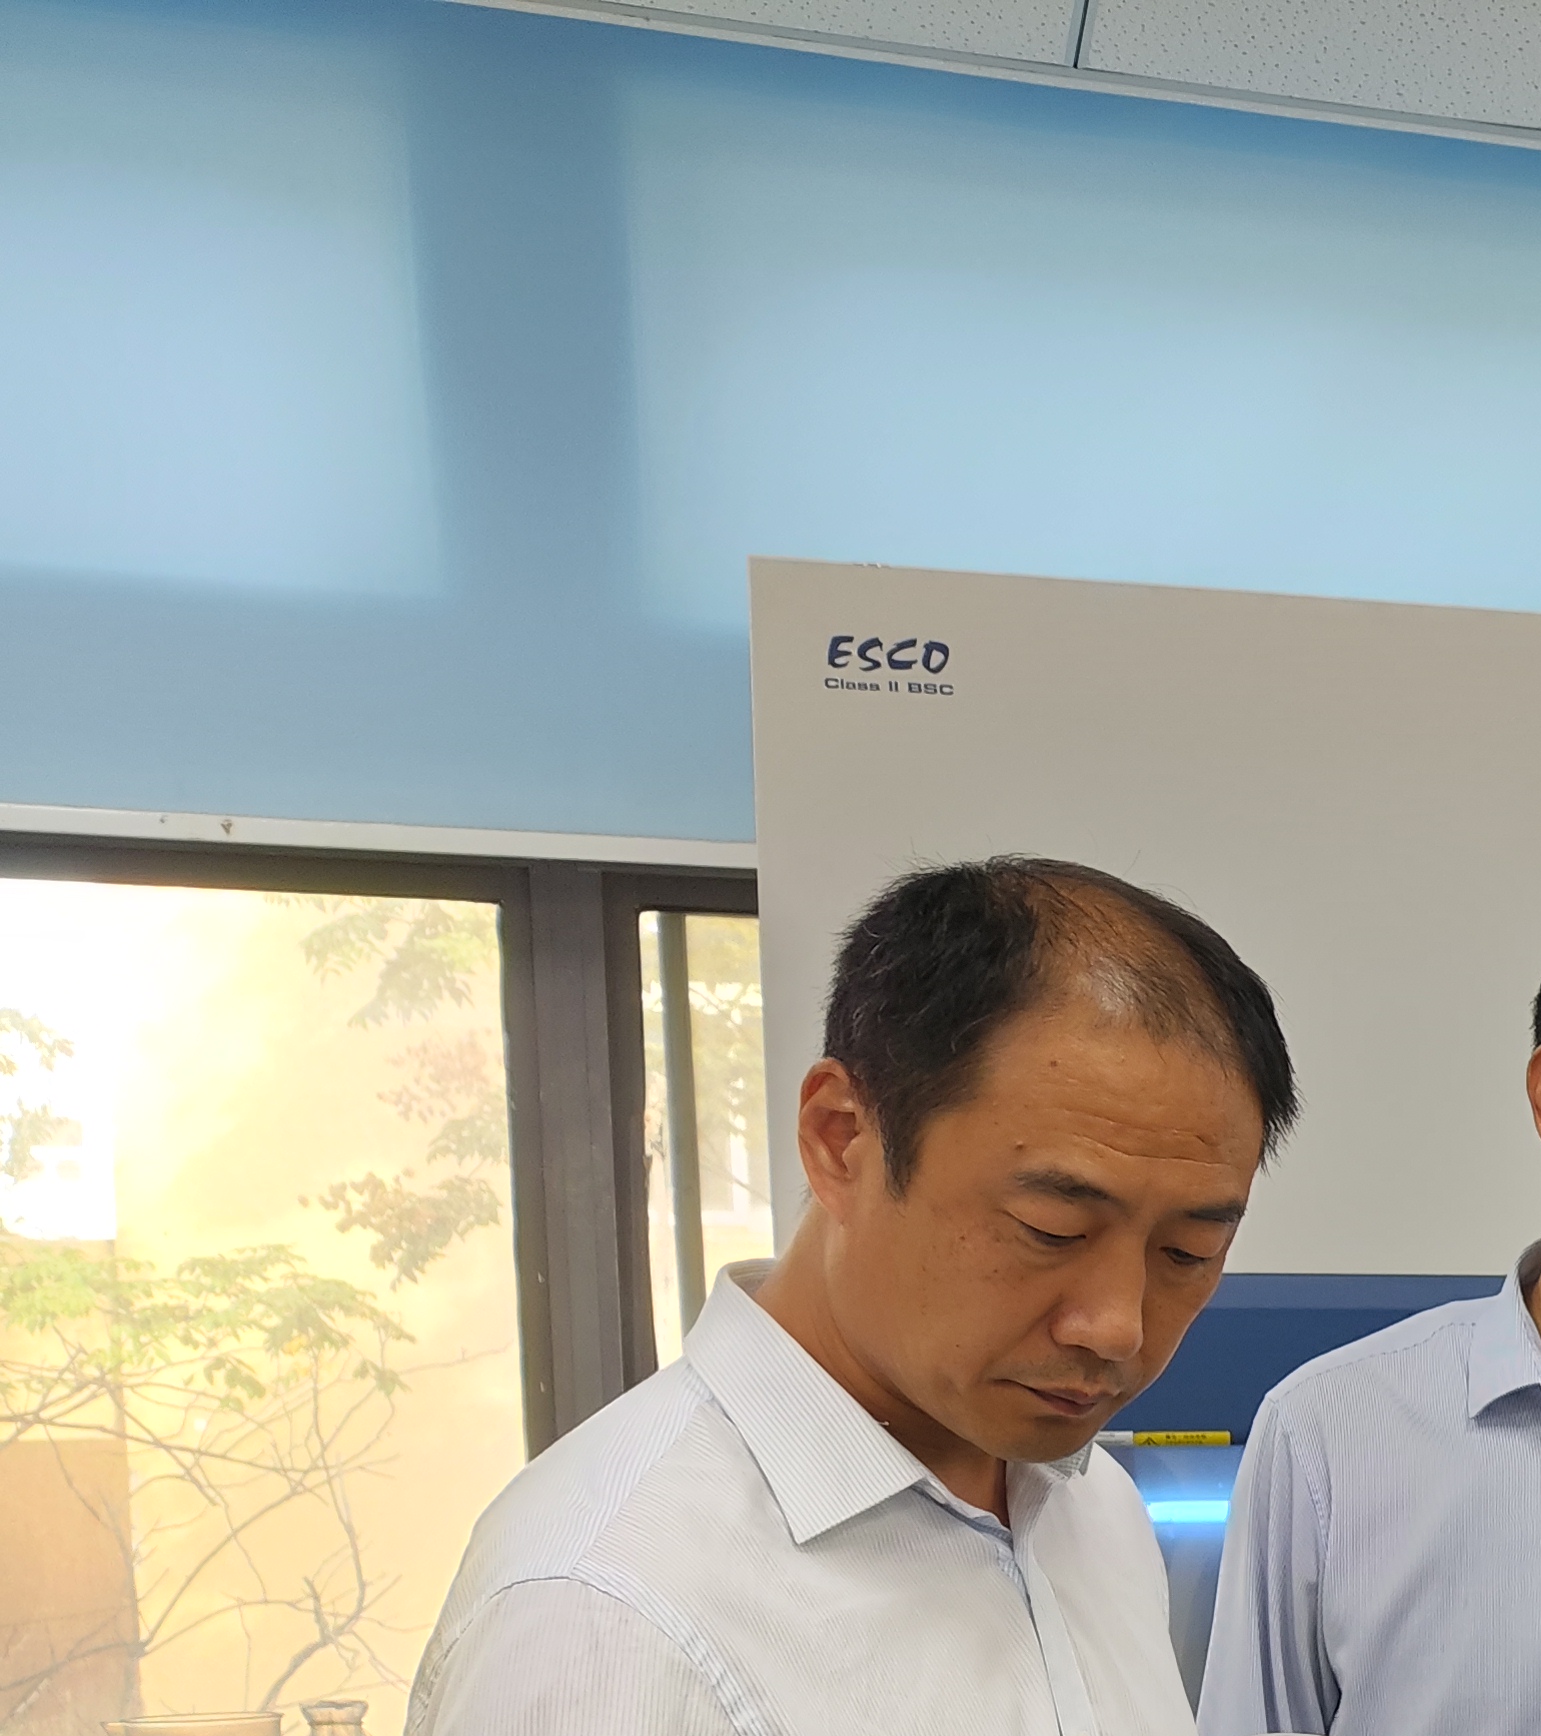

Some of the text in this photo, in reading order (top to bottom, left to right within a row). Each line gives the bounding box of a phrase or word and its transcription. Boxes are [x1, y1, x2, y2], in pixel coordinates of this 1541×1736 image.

[828, 636, 949, 674] ESCO
[824, 677, 880, 692] Class
[908, 682, 954, 696] BSC
